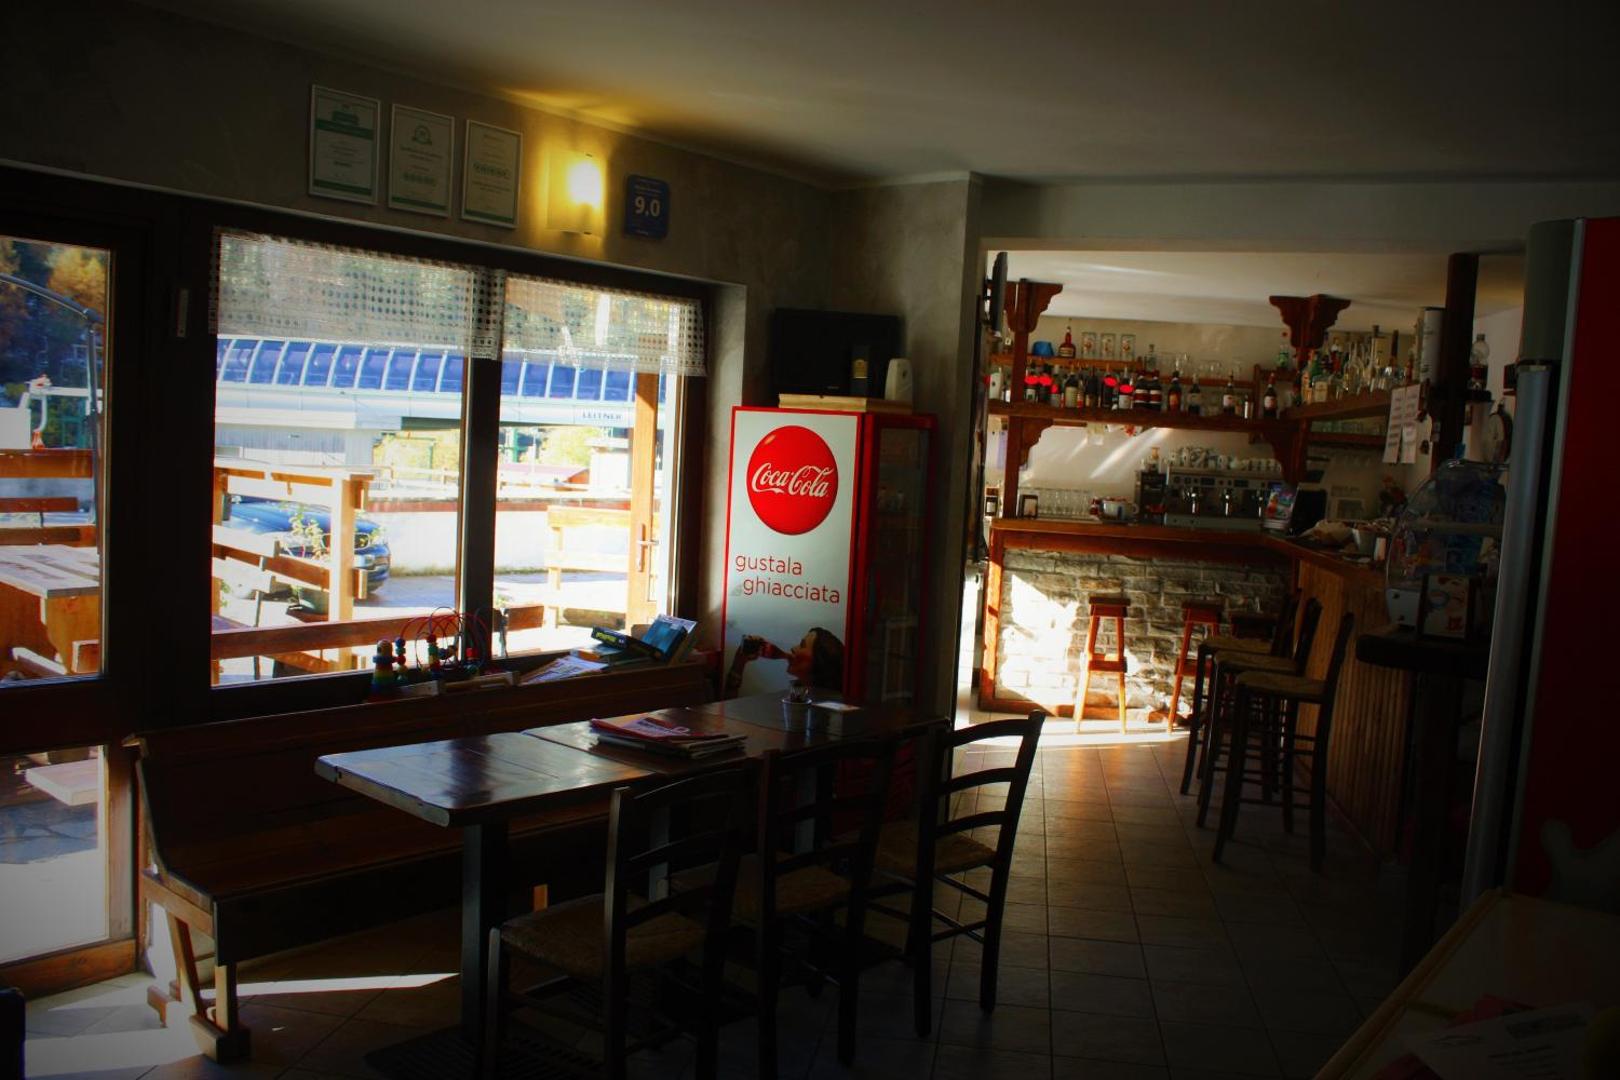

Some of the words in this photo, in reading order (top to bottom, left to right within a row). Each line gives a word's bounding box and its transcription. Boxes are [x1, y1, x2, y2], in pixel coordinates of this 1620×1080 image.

[634, 196, 661, 217] 9.0
[581, 411, 622, 419] LEITNER
[751, 462, 835, 498] Coca-Cola
[735, 553, 803, 576] gustala
[742, 576, 841, 604] ghiacciata
